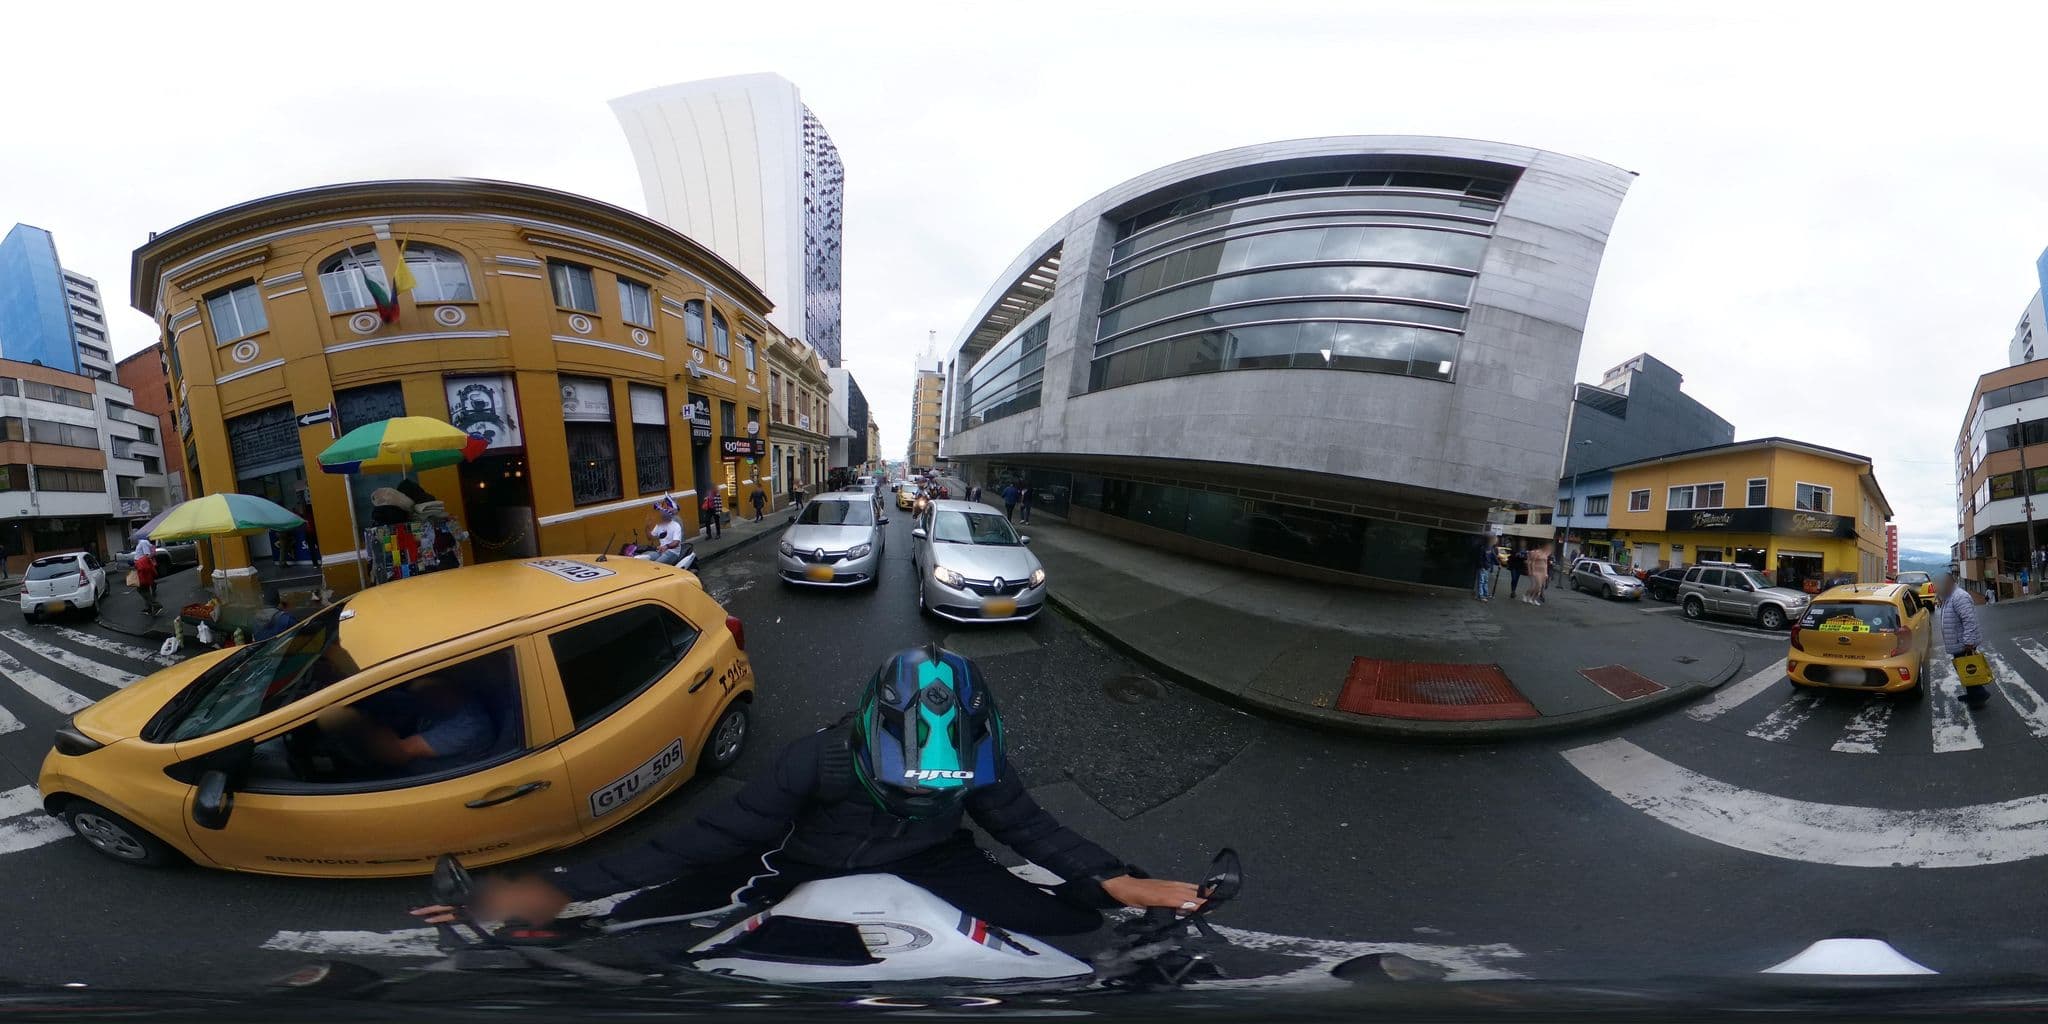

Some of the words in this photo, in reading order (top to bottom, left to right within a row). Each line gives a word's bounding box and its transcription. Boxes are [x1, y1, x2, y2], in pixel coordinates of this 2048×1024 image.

[684, 406, 691, 415] H
[558, 565, 601, 579] GTU
[598, 774, 640, 808] GTU
[652, 744, 681, 777] 505
[904, 769, 975, 780] HRO
[264, 855, 360, 865] SERVICIO
[426, 841, 511, 861] PBLICO
